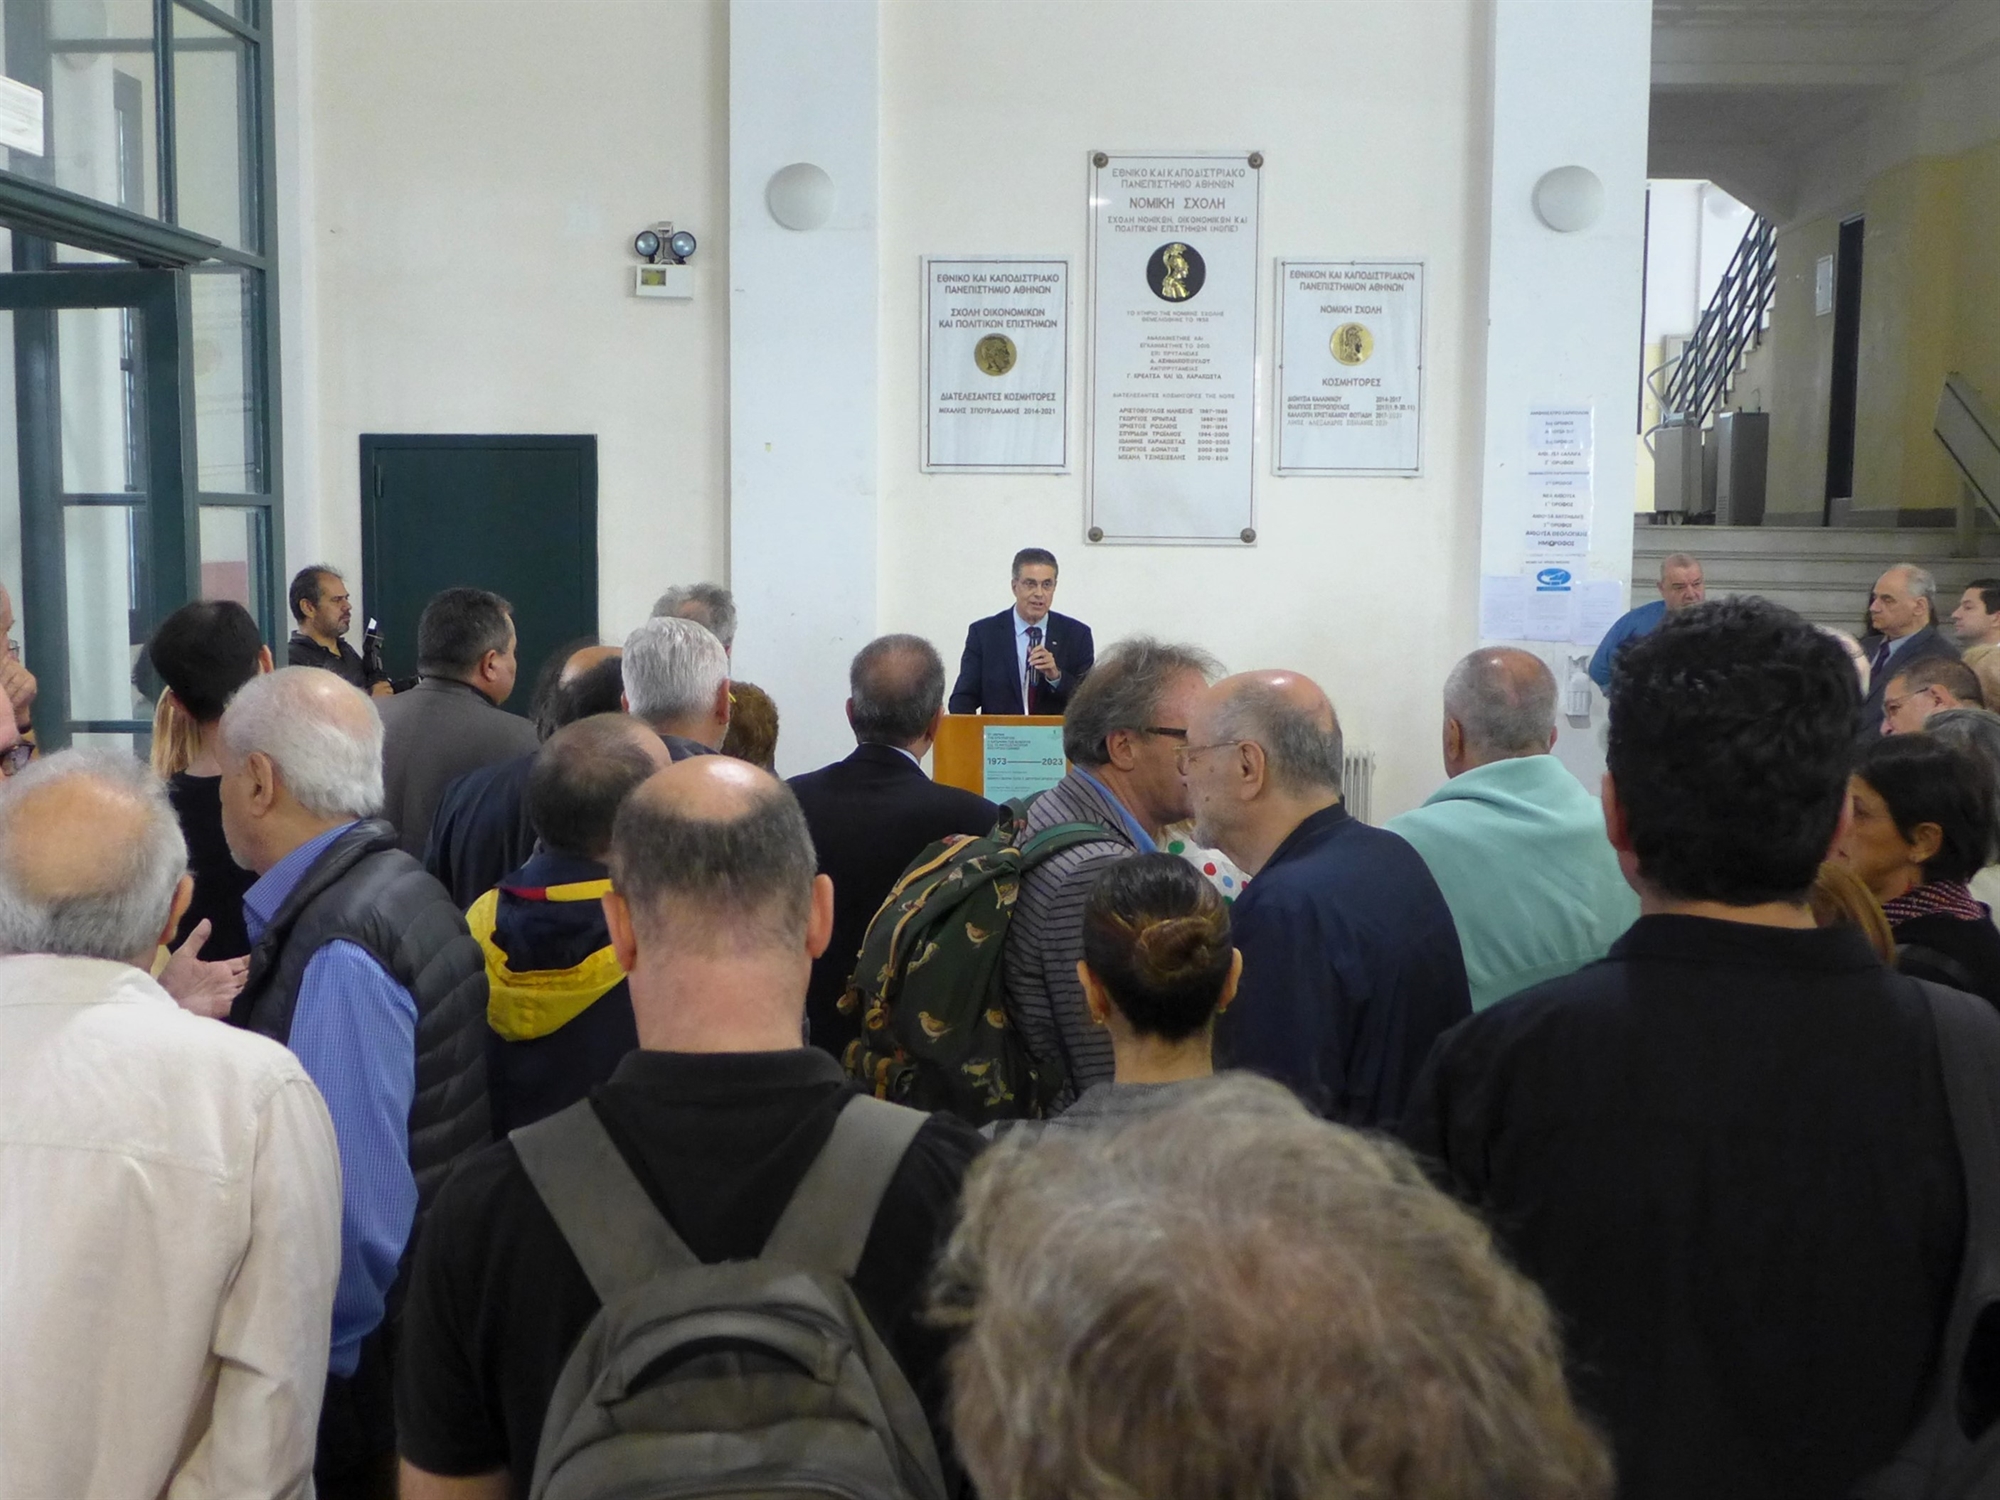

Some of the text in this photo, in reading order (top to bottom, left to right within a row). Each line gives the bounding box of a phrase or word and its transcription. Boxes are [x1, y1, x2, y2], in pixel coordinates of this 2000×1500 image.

[1112, 168, 1246, 178] ΕΘΝΙΚΟ ΚΑΙ ΚΑΠΟΔΙΣΤΡΙΑΚΟ
[1121, 180, 1234, 188] ΠΑΝΕΠΙΣΤΗΜΙΟ ΑΘΗΝΩΝ
[1129, 197, 1226, 209] ΝΟΜΙΚΗ ΣΧΟΛΗ
[937, 274, 1060, 283] ΕΘΝΙΚΟ ΚΑΙ ΚΑΠΟΔΙΣΤΡΙΑΚΟ
[1290, 270, 1415, 280] ΕΘΝΙΚΟΝ ΚΑΙ ΚΑΠΟΔΙΣΤΡΙΑΚΟΝ
[945, 285, 1051, 294] ΠΑΝΕΠΙΣΤΗΜΙΟ ΑΘΗΝΩΝ
[1300, 282, 1404, 292] ΠΑΝΕΠΙΣΤΗΜΙΟΝ ΑΘΗΝΩΝ
[950, 308, 1045, 317] ΣΧΟΛΗ ΟΙΚΟΝΟΜΙΚΩΝ
[1320, 305, 1382, 314] ΝΟΜΙΚΗ ΣΧΟΛΗ
[939, 320, 1058, 328] ΚΑΙ ΠΟΛΙΤΙΚΩΝ ΕΠΙΣΤΗΜΩΝ
[1322, 378, 1382, 387] ΚΟΣΜΗΤΟΡΕΣ
[940, 392, 1056, 401] ΔΙΑΤΕΛΕΣΑΝΤΕΣ ΚΟΣΜΗΤΟΡΕΣ
[987, 758, 1064, 766] 1973 2023
